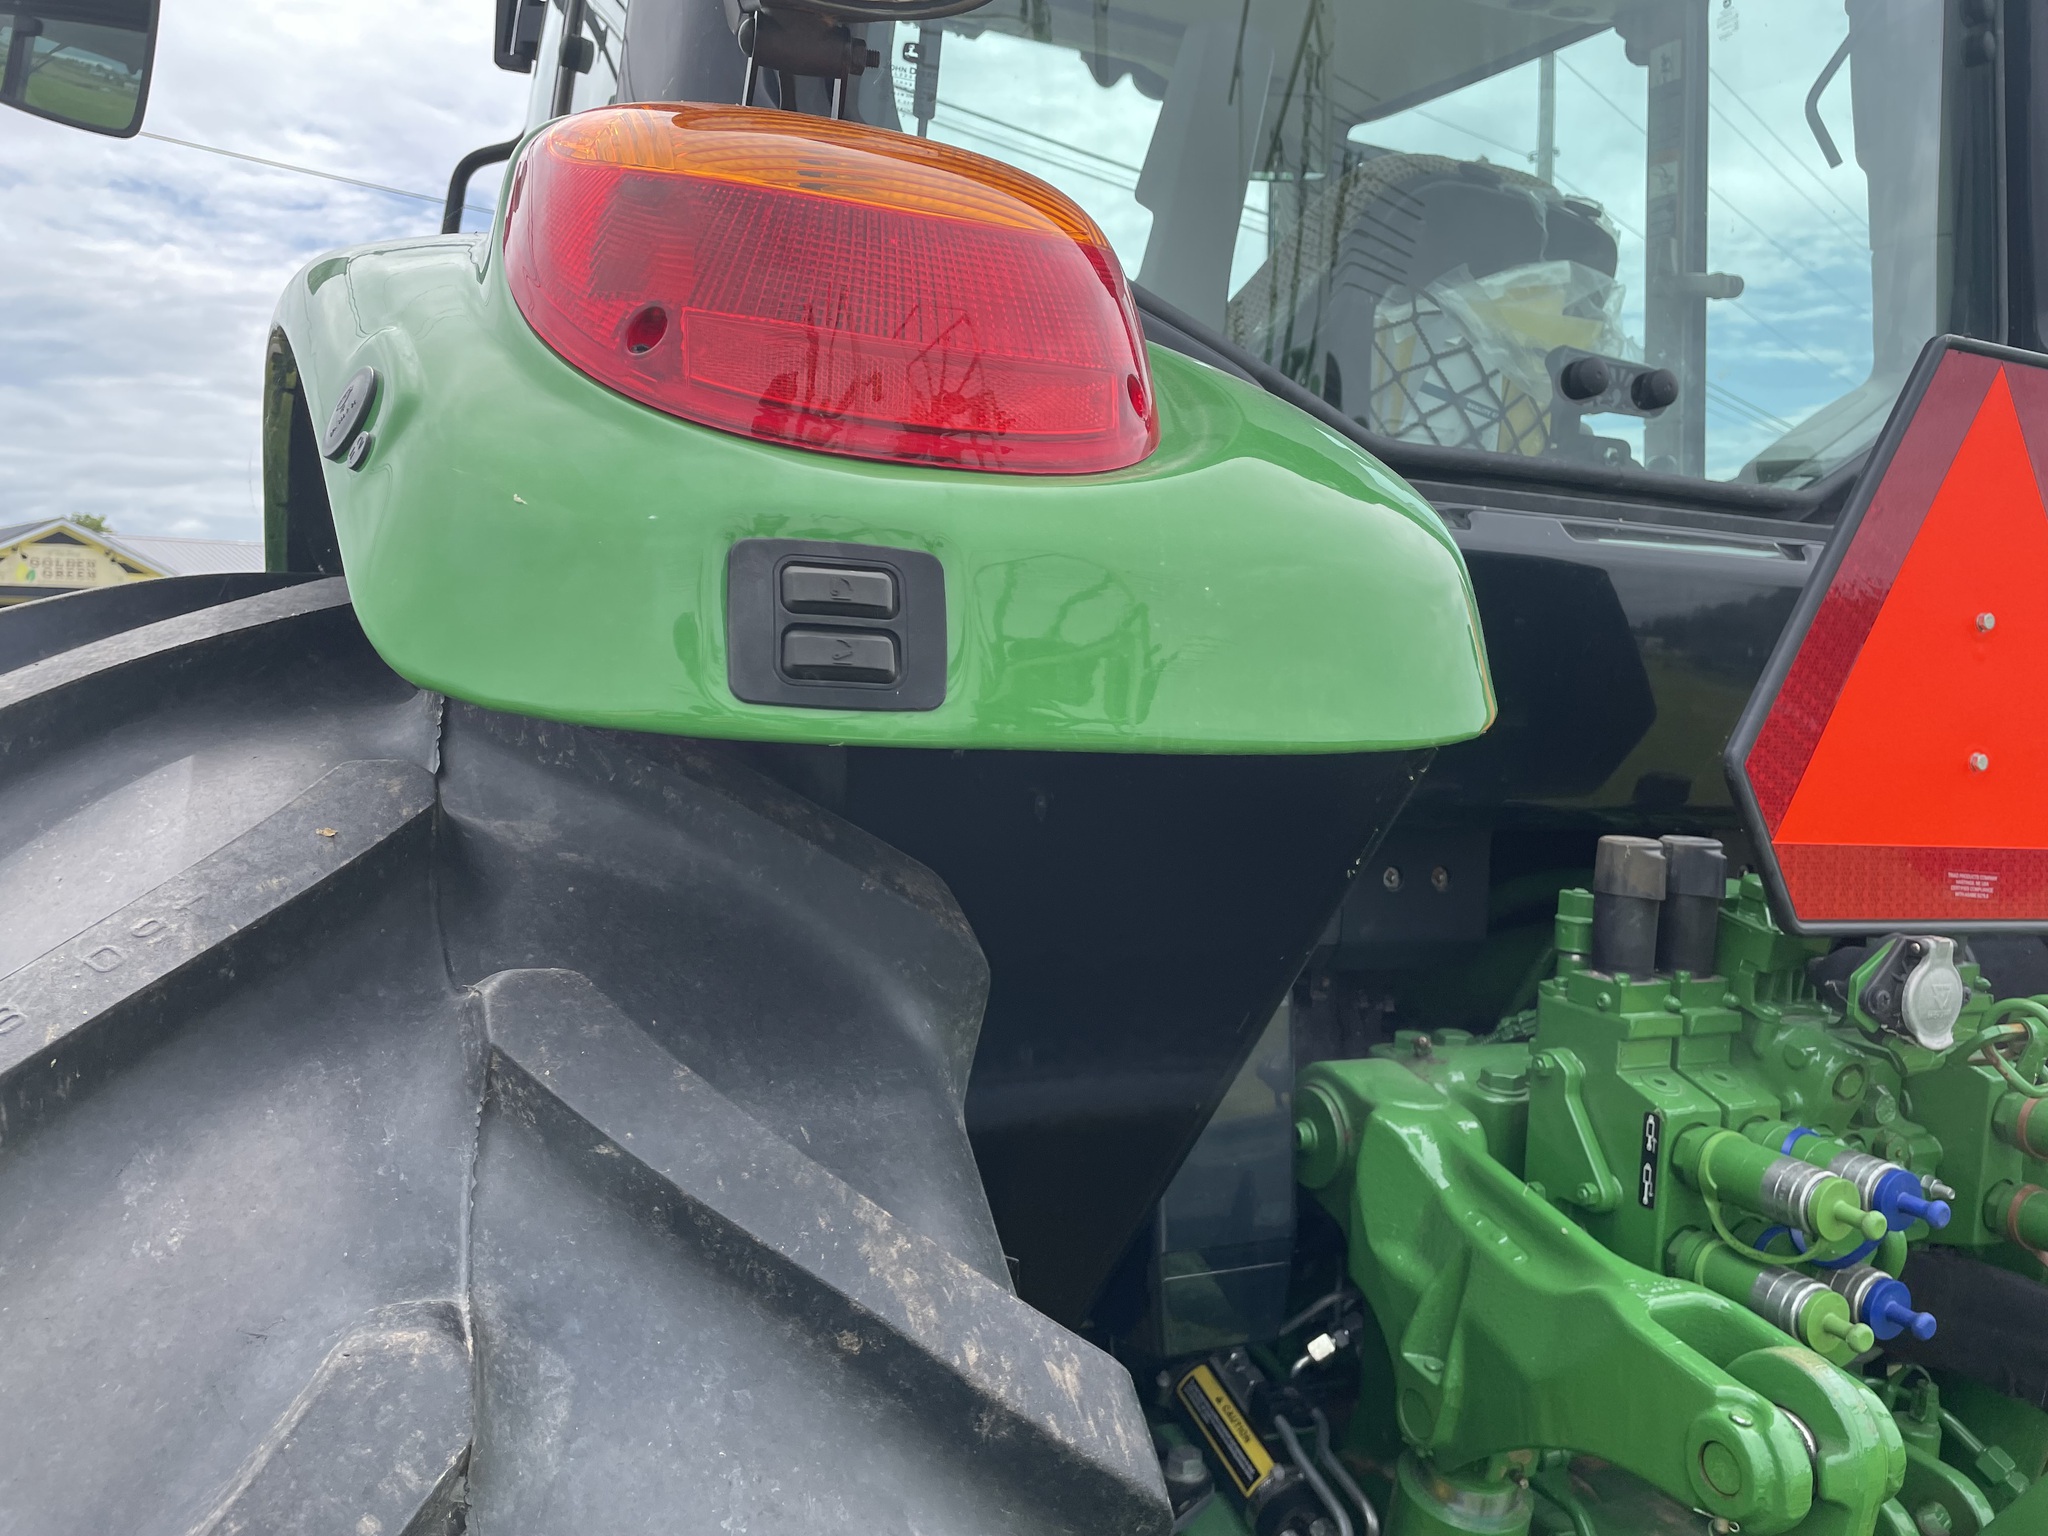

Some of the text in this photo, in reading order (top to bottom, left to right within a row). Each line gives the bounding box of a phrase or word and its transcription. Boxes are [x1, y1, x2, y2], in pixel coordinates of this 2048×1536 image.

[30, 557, 96, 568] GOLDEN
[42, 568, 96, 580] GREEN
[1221, 1404, 1250, 1443] CAUTION
